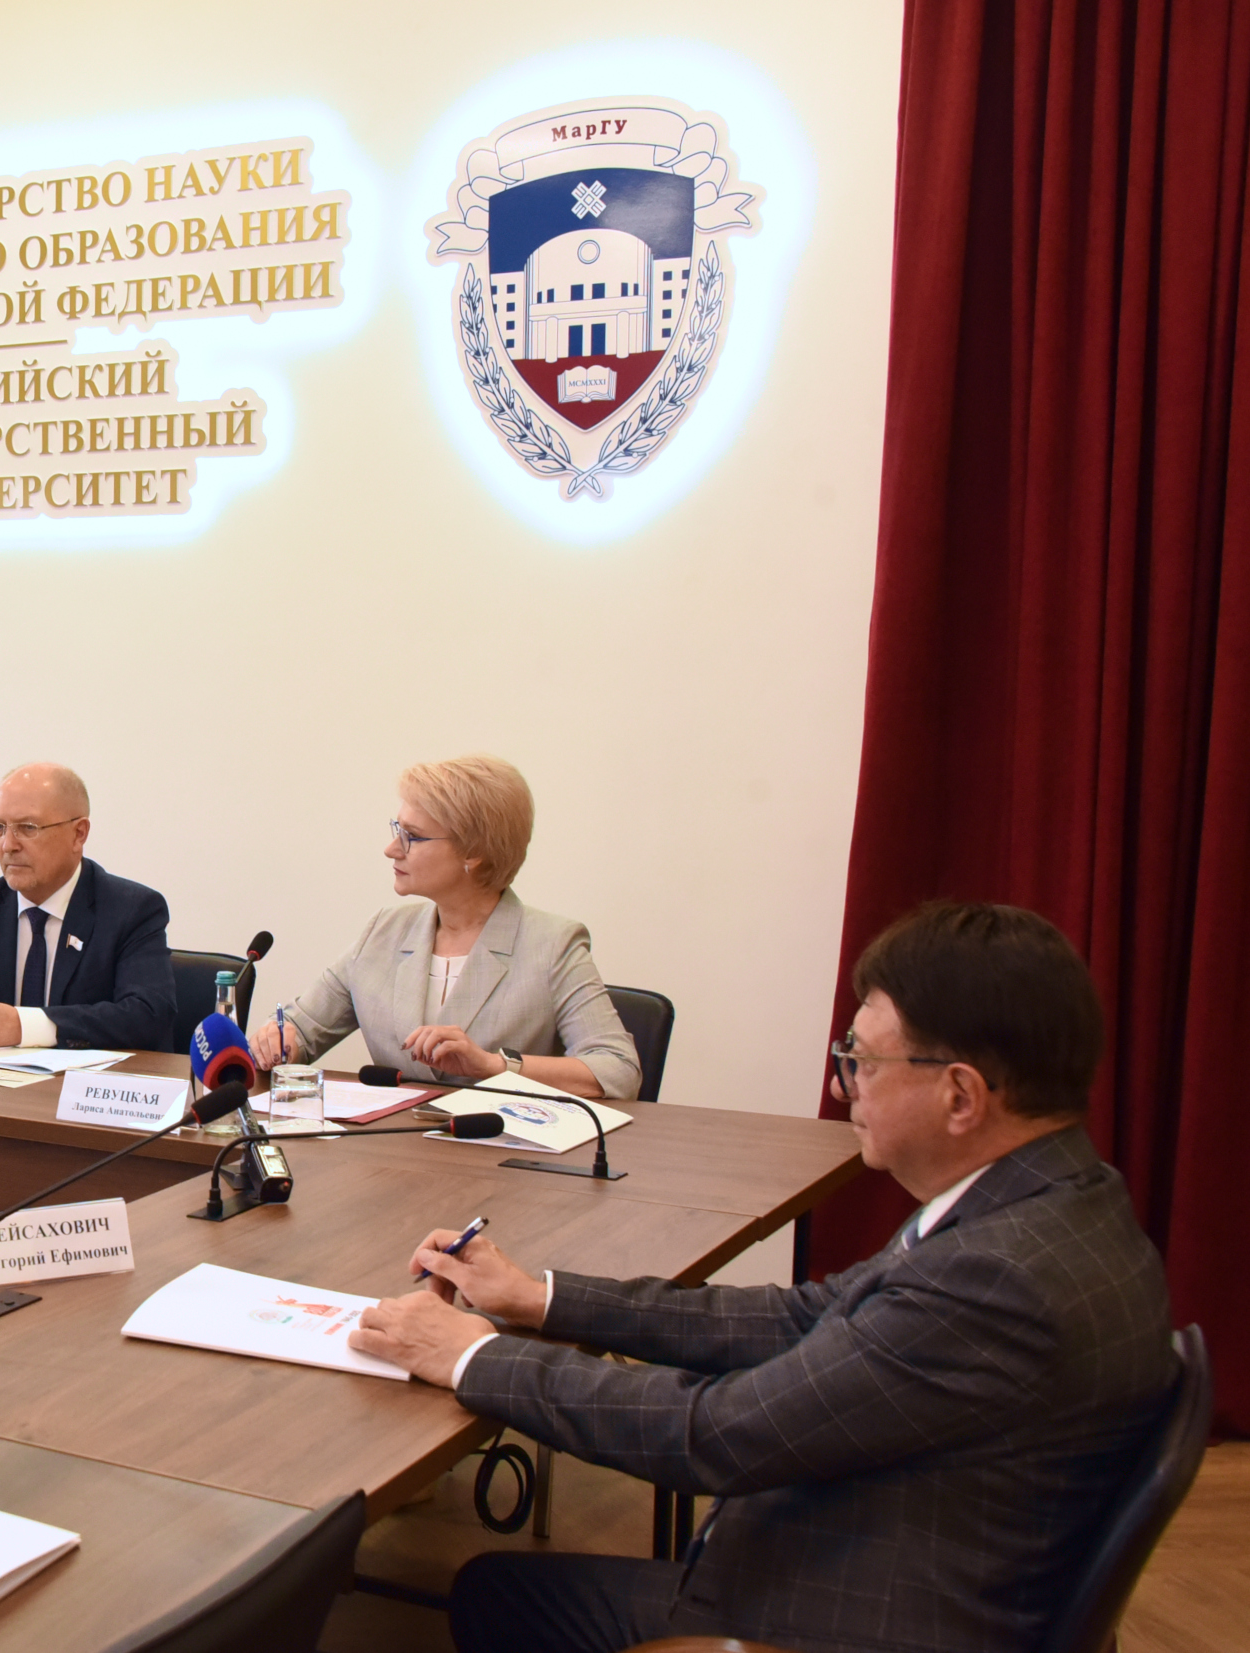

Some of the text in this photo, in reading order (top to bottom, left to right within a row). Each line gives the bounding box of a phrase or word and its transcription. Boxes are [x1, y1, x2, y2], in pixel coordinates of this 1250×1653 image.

[551, 119, 627, 142] МарГУ
[144, 148, 305, 204] НАУКИ
[18, 202, 343, 272] ОБРАЗОВАНИЯ
[56, 261, 335, 324] ФЕДЕРАЦИИ
[568, 378, 606, 387] MCMXXXI
[85, 1086, 160, 1106] РЕВУЦКАЯ
[71, 1102, 104, 1114] Лариса
[50, 1245, 128, 1266] Ефимович
